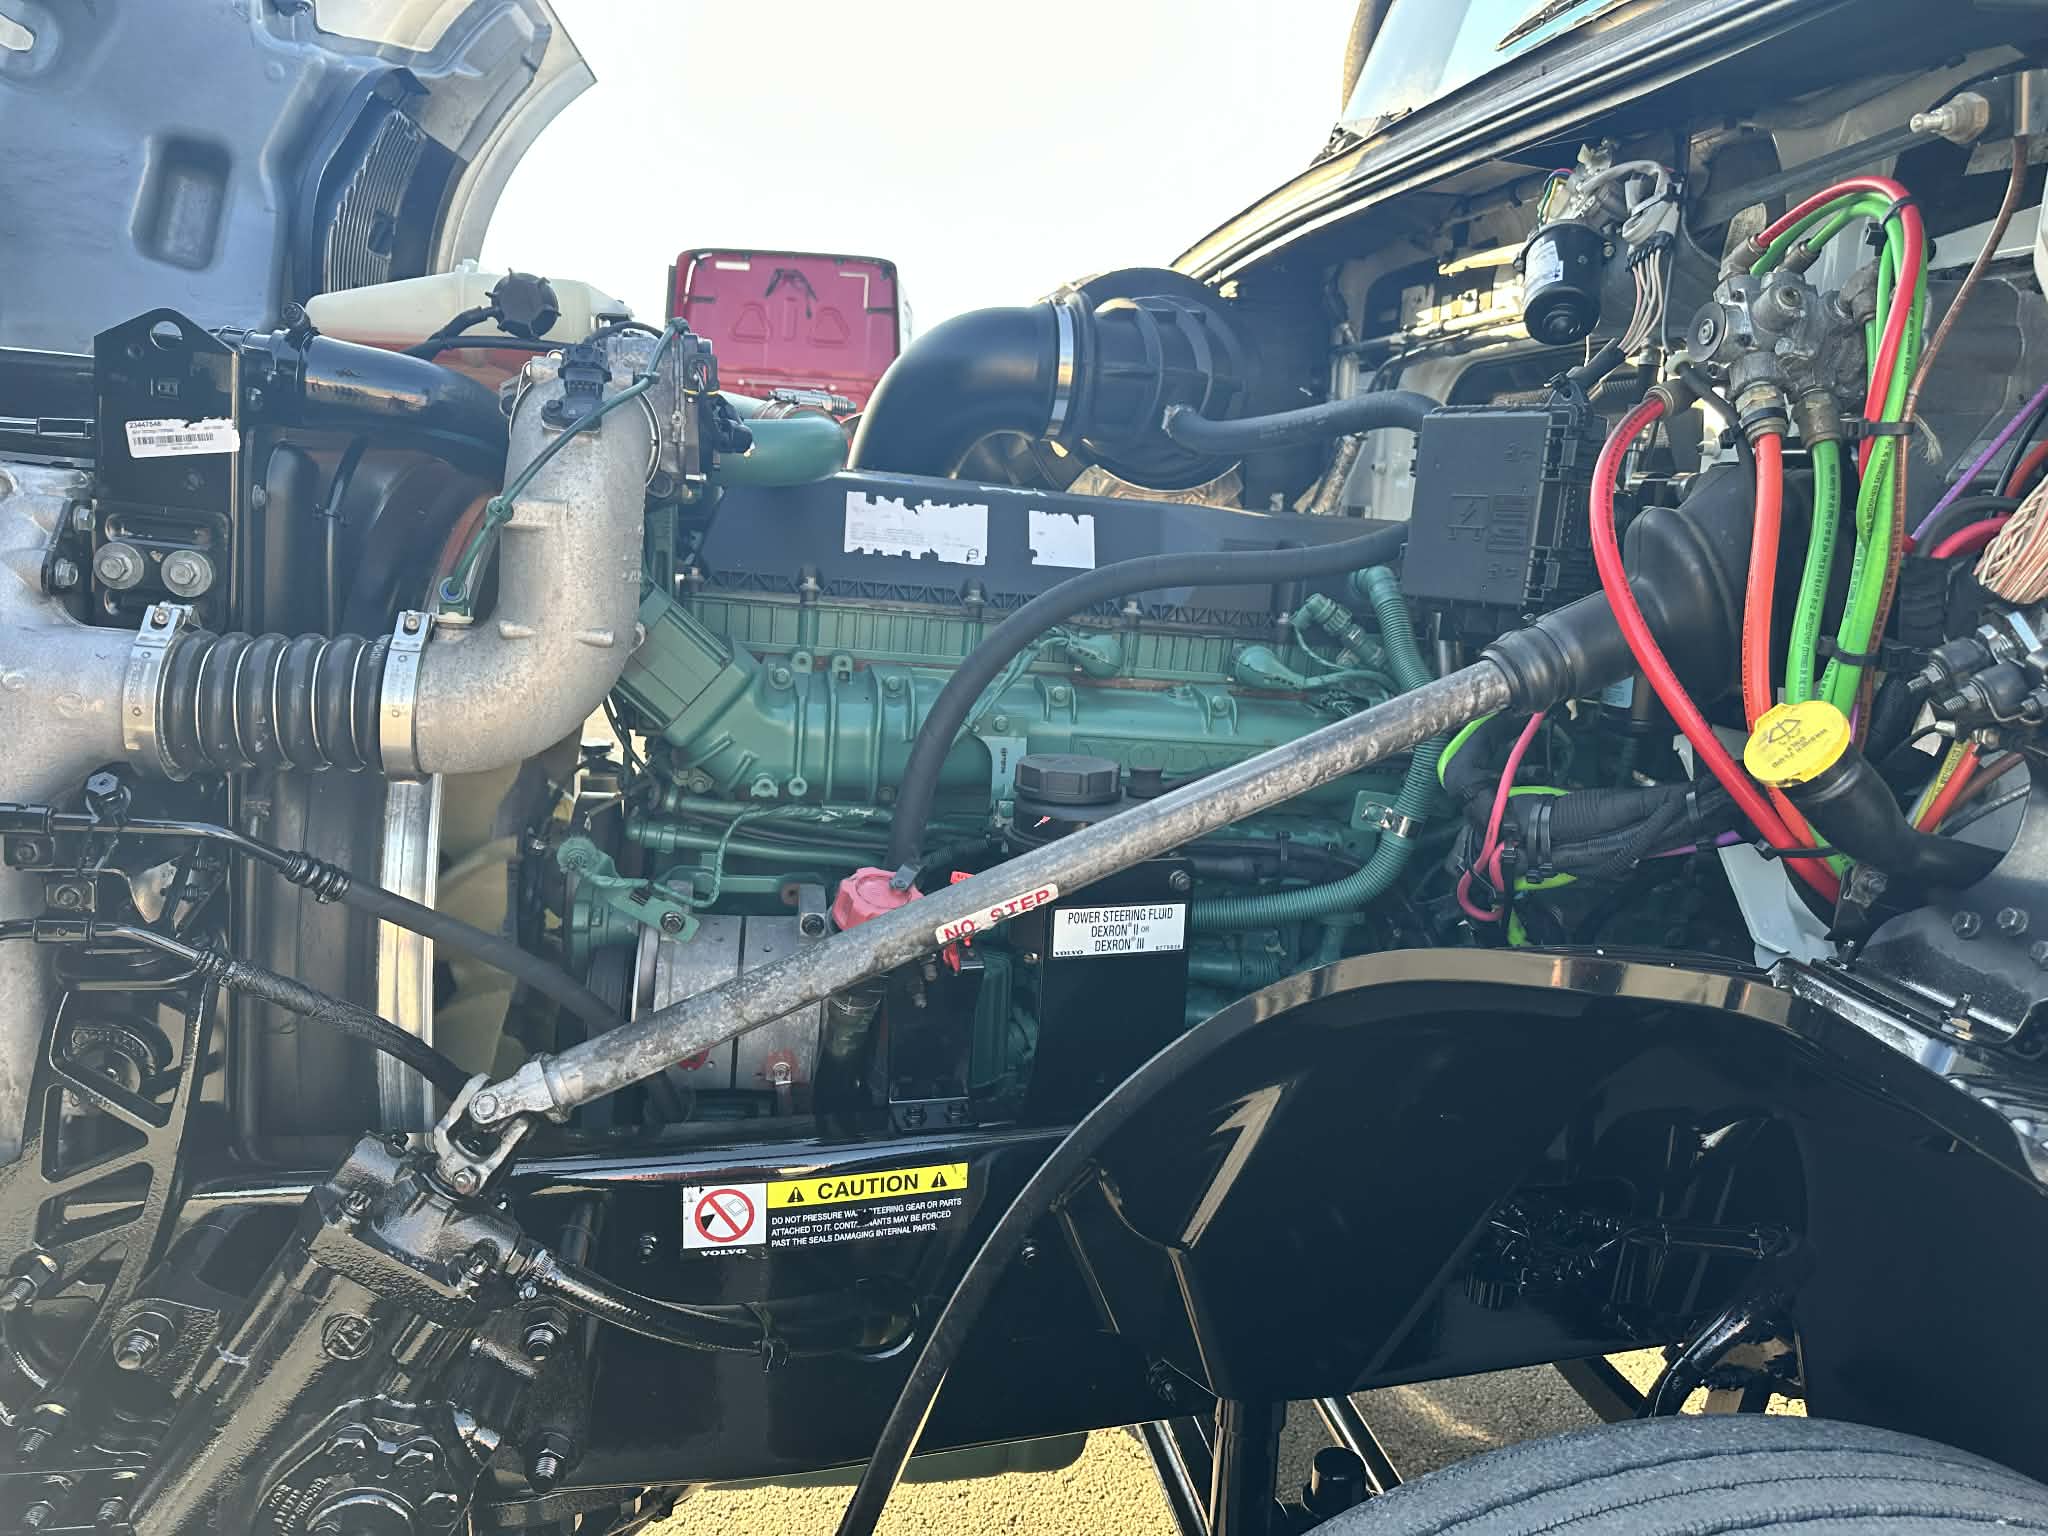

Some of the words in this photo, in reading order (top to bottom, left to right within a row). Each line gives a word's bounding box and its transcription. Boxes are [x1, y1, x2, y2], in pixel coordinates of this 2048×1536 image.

[943, 919, 975, 941] NO
[990, 889, 1050, 922] STEP
[1068, 911, 1100, 925] POWER
[1102, 909, 1146, 923] STEERING
[1148, 907, 1173, 920] FLUID
[817, 1174, 919, 1199] CAUTION
[771, 1217, 784, 1225] DO
[785, 1215, 801, 1224] NOT
[802, 1211, 843, 1223] PRESSURE
[905, 1202, 926, 1212] GEAR
[927, 1200, 938, 1209] OR
[939, 1198, 962, 1208] PARTS
[771, 1226, 811, 1237] ATTACHED
[812, 1224, 822, 1233] TO
[824, 1223, 832, 1232] IT.
[893, 1214, 909, 1224] MAY
[910, 1213, 921, 1222] BE
[922, 1210, 952, 1221] FORCED
[771, 1238, 790, 1248] PAST
[792, 1237, 808, 1246] THE
[809, 1234, 833, 1245] SEALS
[834, 1229, 875, 1242] DAMAGING
[876, 1226, 912, 1237] INTERNAL
[913, 1222, 938, 1233] PARTS.
[701, 1248, 747, 1257] VOLVO
